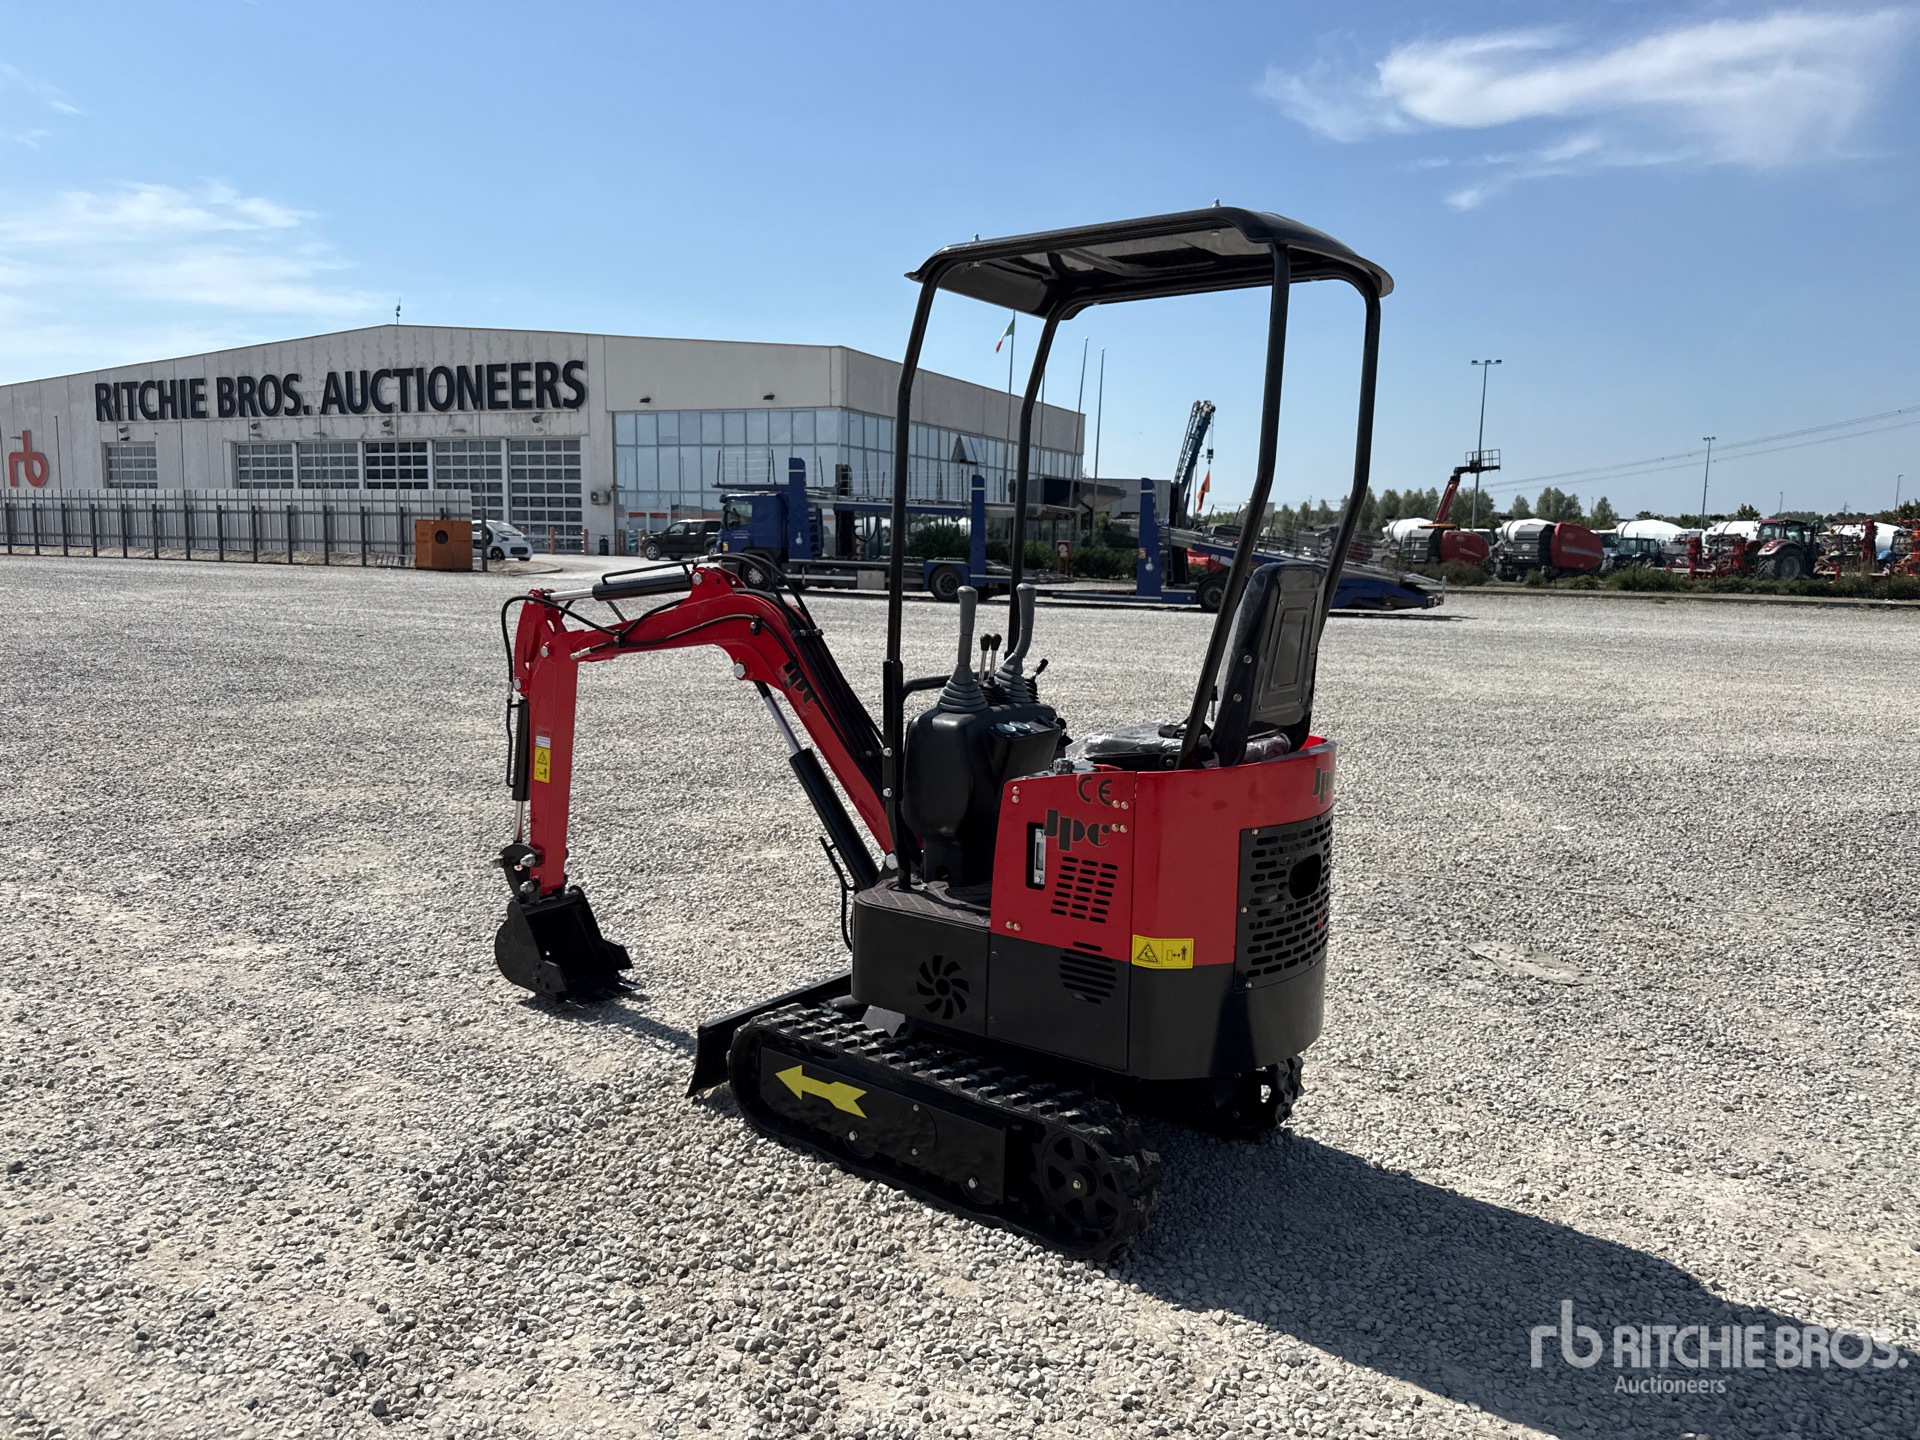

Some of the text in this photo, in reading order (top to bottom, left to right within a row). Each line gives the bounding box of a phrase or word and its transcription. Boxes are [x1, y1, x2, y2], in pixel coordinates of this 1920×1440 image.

[95, 360, 588, 421] RITCHIE BROS. AUCTIONEERS
[1078, 775, 1113, 807] CE
